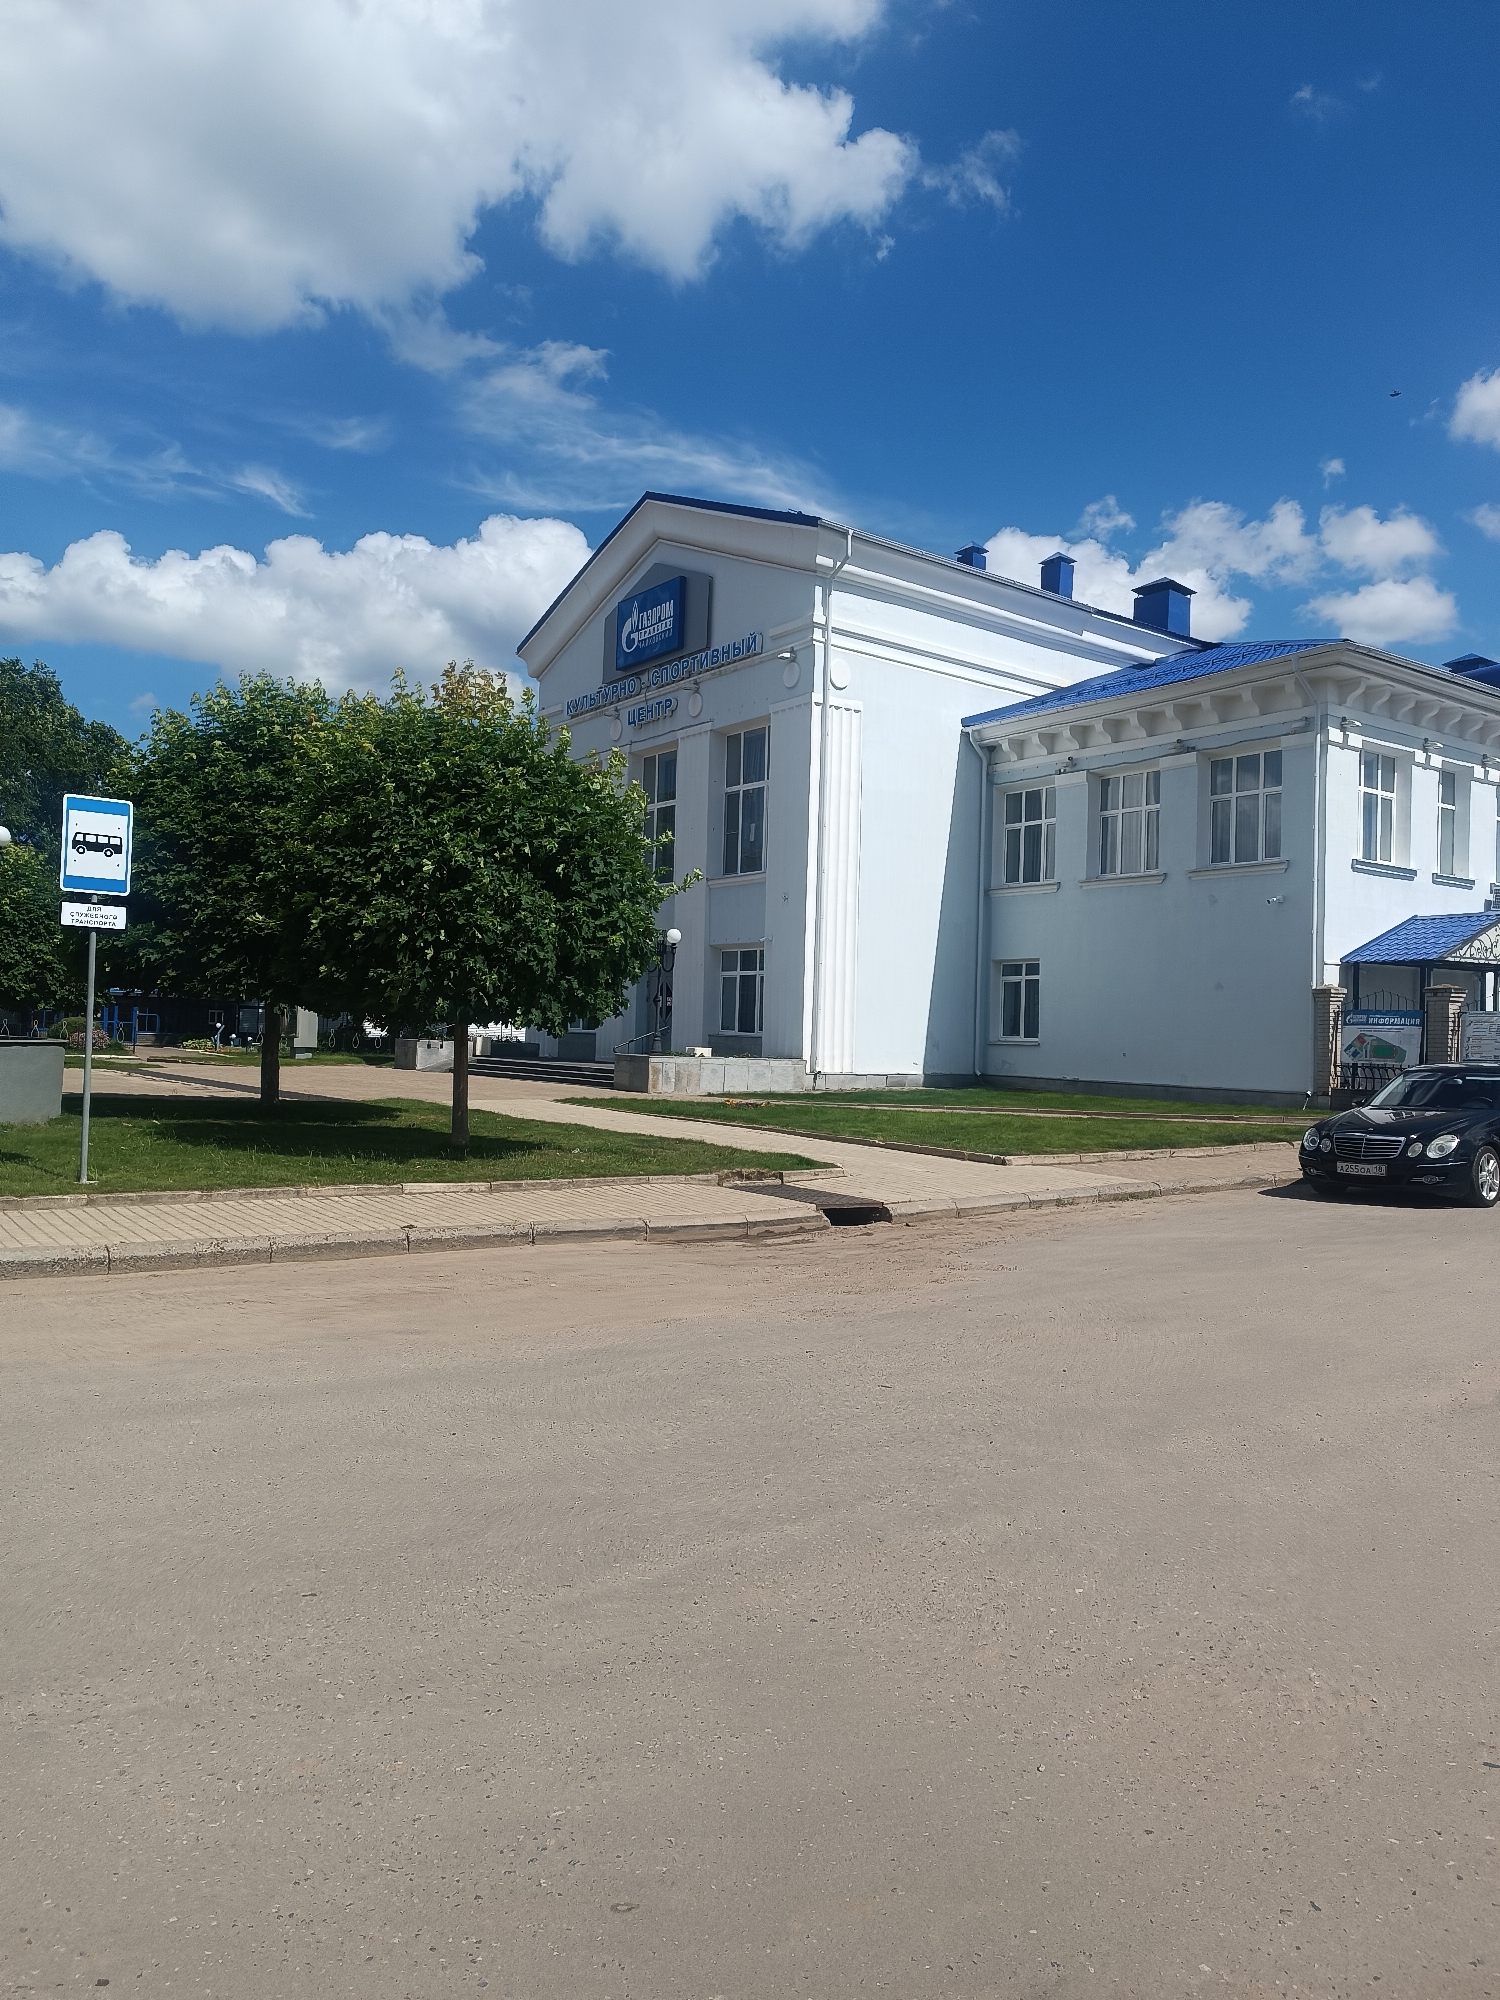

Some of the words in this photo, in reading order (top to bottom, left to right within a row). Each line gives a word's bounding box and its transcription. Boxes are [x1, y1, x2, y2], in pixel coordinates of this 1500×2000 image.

[639, 599, 674, 630] ГАЗПРОМ
[566, 678, 637, 716] КУЛЬТУРНО
[651, 632, 758, 687] СПОРТИВНЫЙ
[627, 698, 673, 727] ЦЕНТР
[71, 918, 117, 927] ТРАНСПОРТА
[1368, 1017, 1421, 1026] ИНФОРМАЦИЯ
